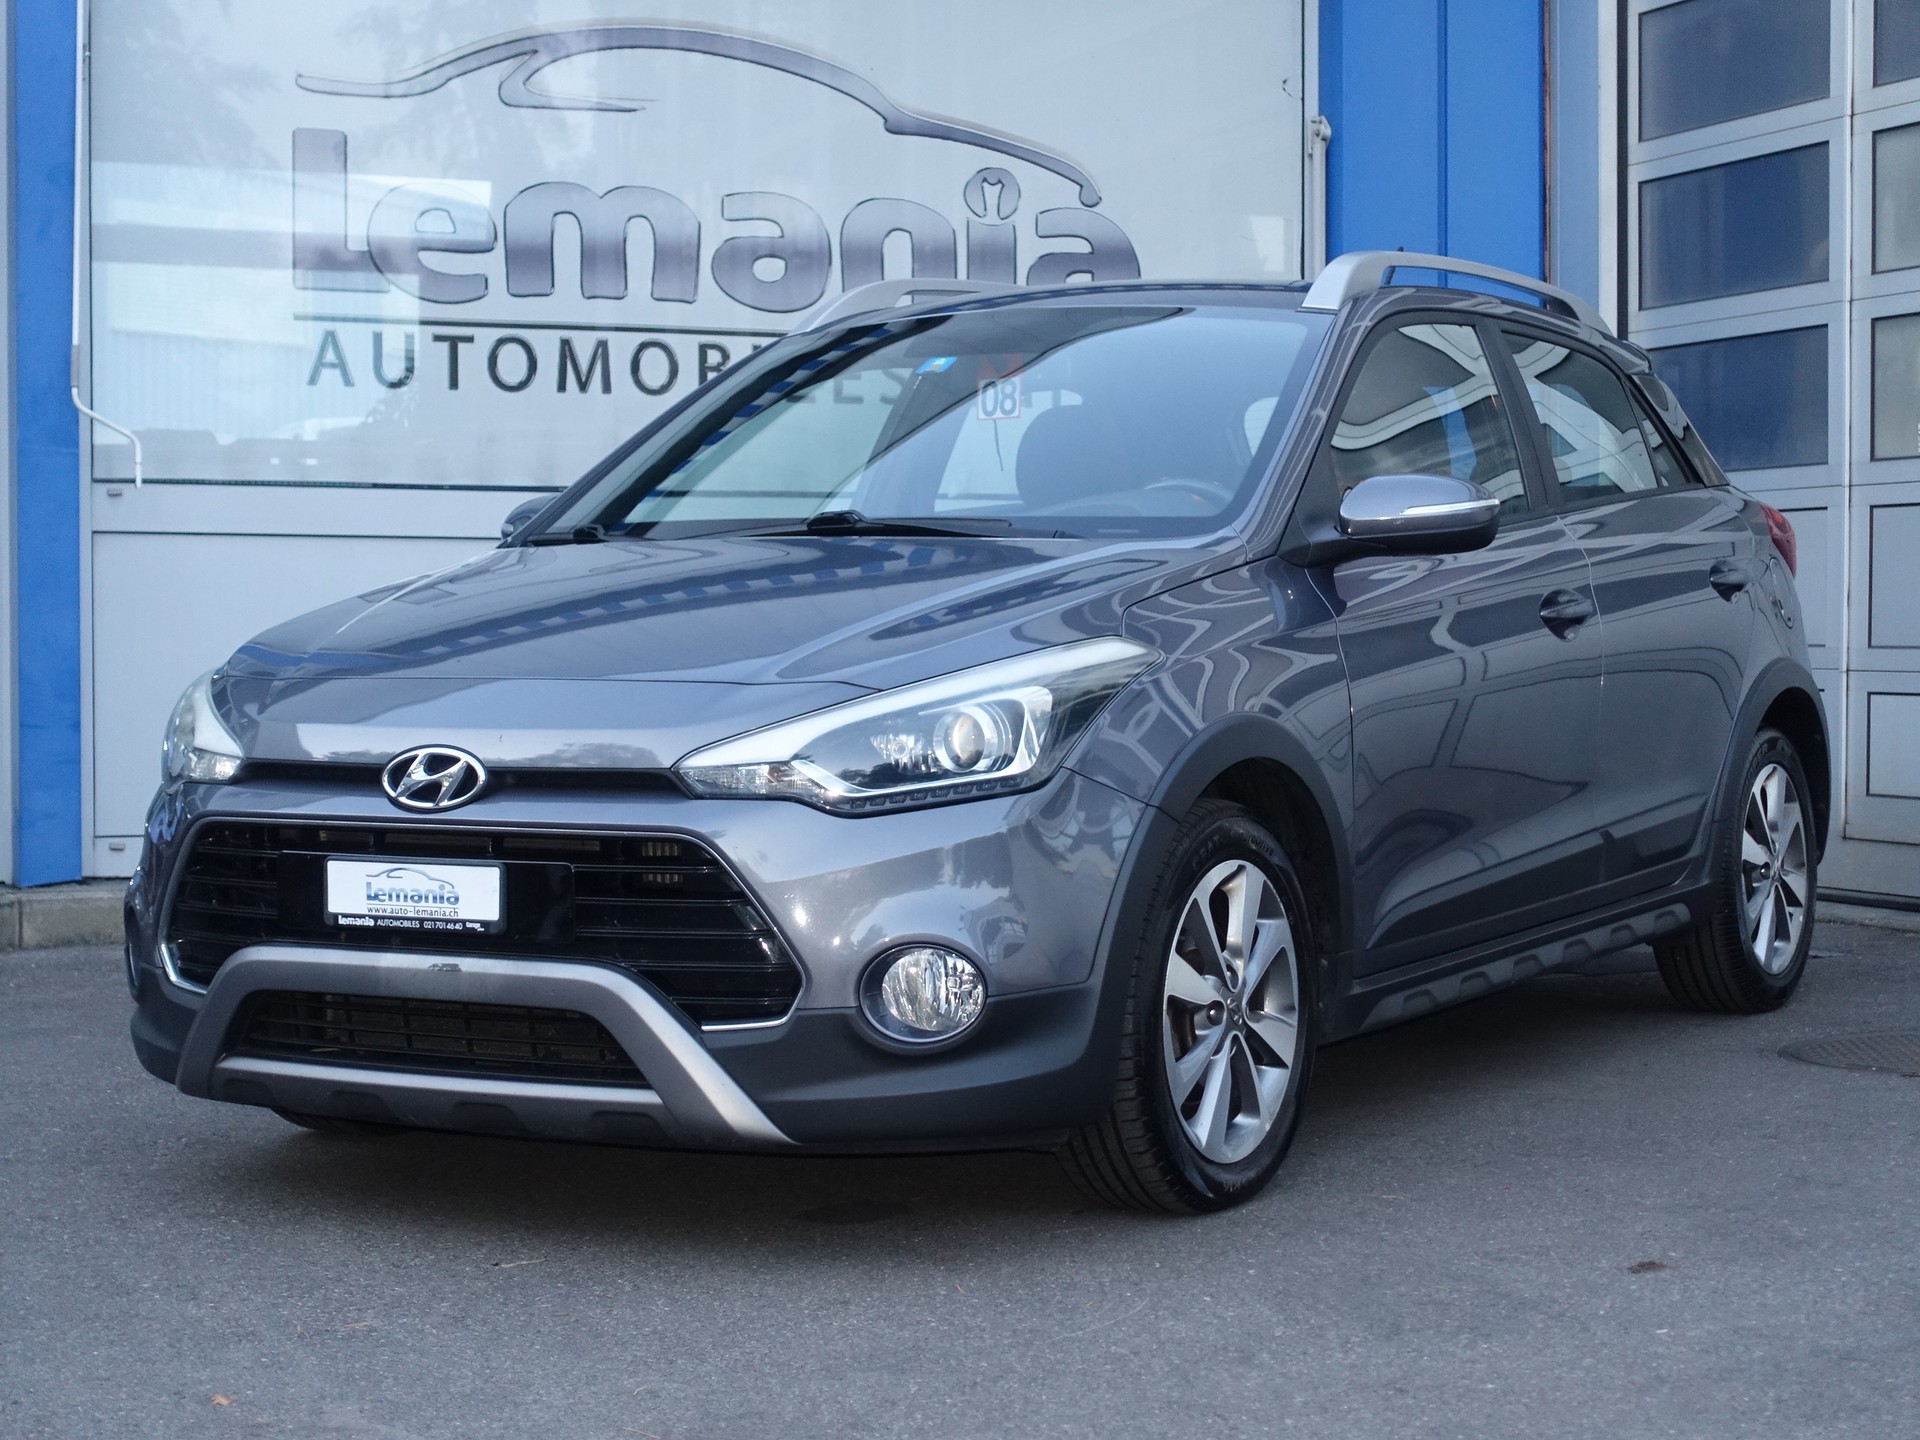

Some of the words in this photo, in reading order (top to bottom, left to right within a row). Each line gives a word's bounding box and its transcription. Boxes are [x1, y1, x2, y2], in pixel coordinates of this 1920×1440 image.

[292, 127, 1142, 314] Lemania
[306, 328, 902, 406] AUTOMOBES
[366, 882, 460, 906] Lemania
[367, 906, 459, 918] www.auto-lemania.ch
[377, 918, 420, 928] AUTOMOBILES
